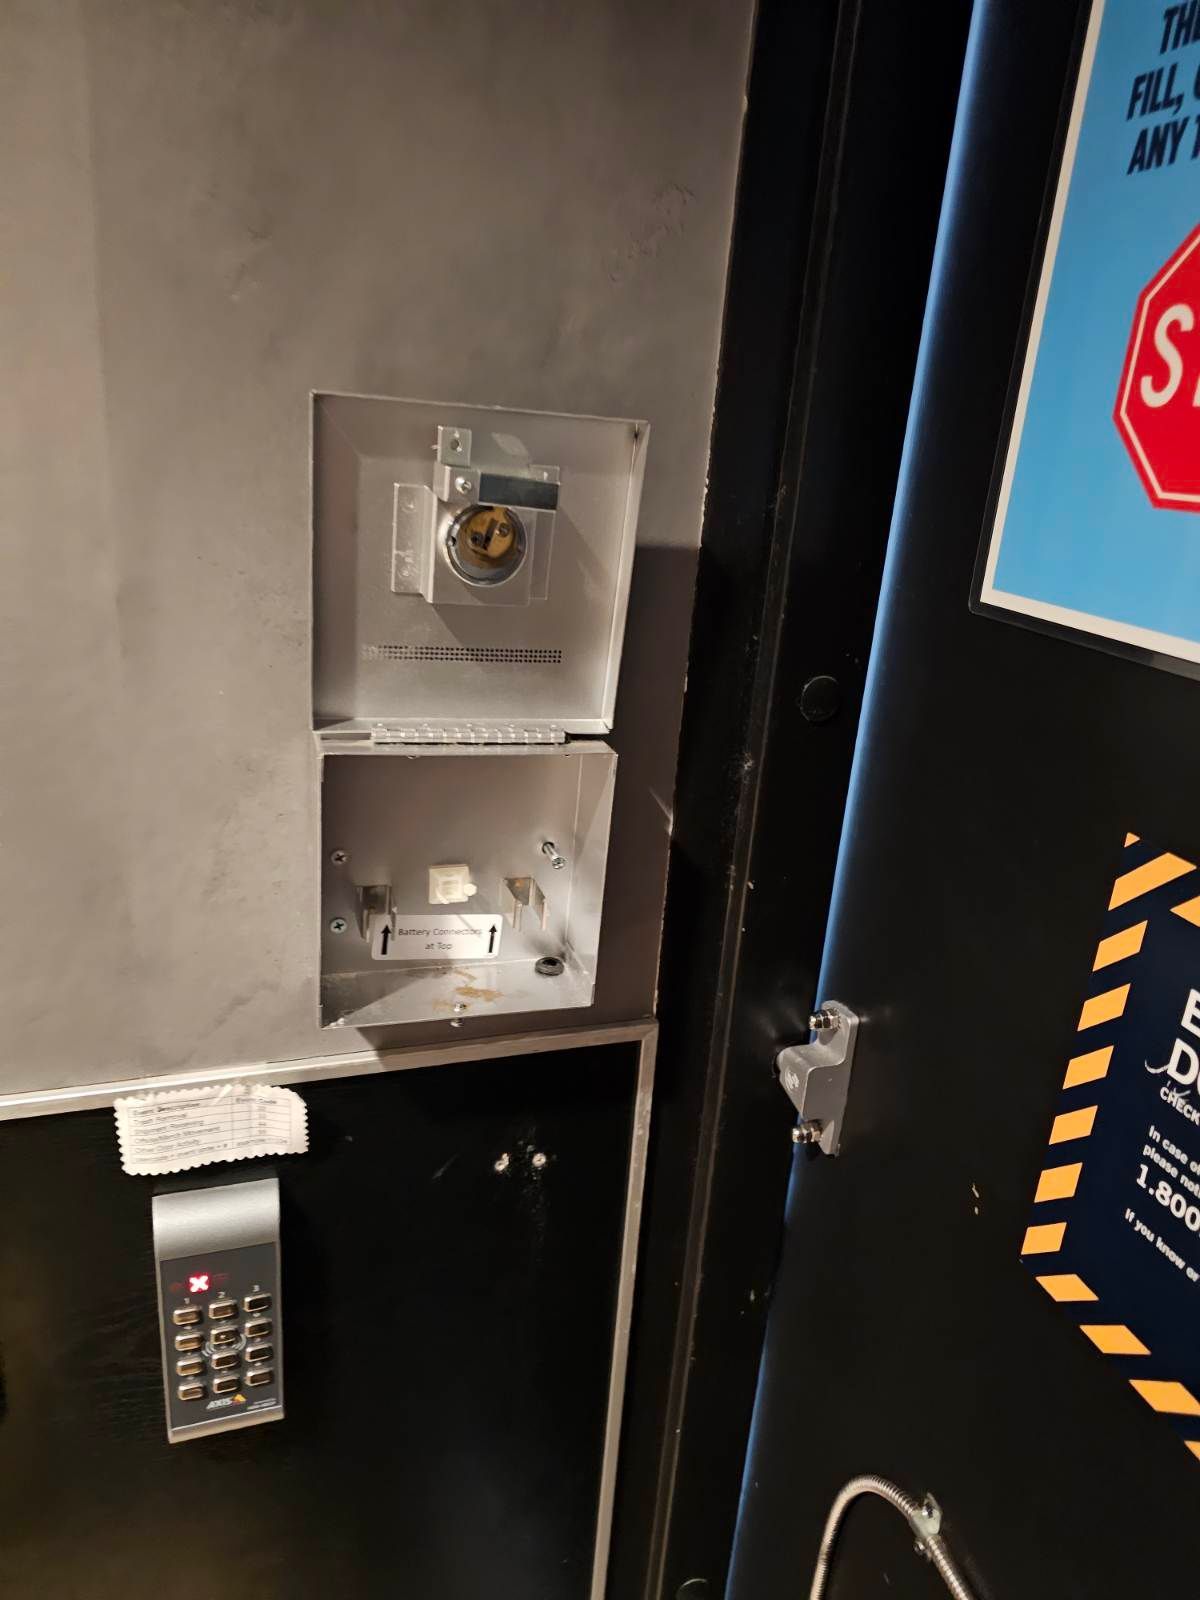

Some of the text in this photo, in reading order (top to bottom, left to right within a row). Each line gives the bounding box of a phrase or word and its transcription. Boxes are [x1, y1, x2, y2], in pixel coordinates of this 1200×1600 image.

[1127, 63, 1184, 121] FILL,
[1127, 116, 1190, 175] ANY
[1141, 303, 1200, 408] S
[398, 928, 430, 938] Battery
[437, 942, 453, 951] Top
[1160, 1086, 1200, 1126] CHECK
[1143, 1144, 1178, 1178] please
[1148, 1125, 1161, 1143] In
[1162, 1139, 1188, 1165] case
[1125, 1208, 1136, 1223] If
[1134, 1219, 1155, 1242] you
[1156, 1236, 1186, 1269] know
